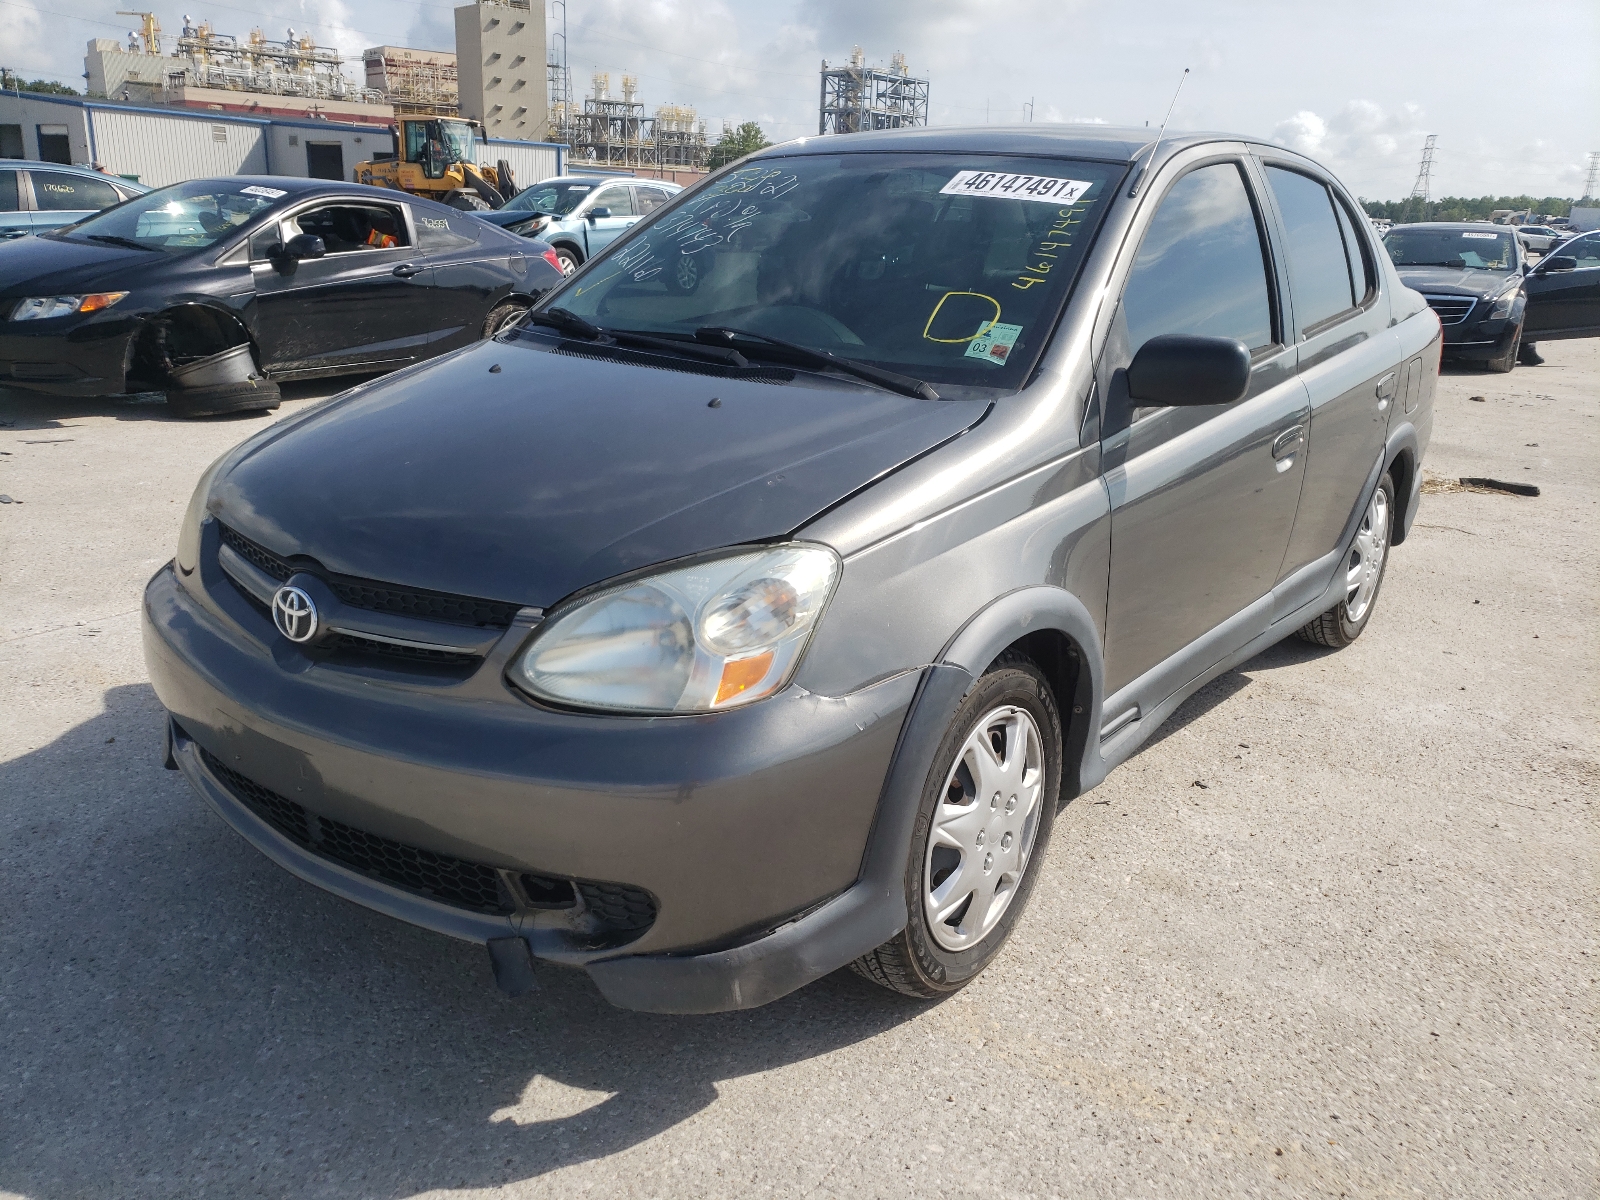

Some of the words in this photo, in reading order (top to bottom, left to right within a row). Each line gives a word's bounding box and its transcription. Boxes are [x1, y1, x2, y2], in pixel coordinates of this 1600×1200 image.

[964, 172, 1070, 197] 46147491
[986, 322, 1018, 332] Luisiana
[972, 342, 988, 353] 03
